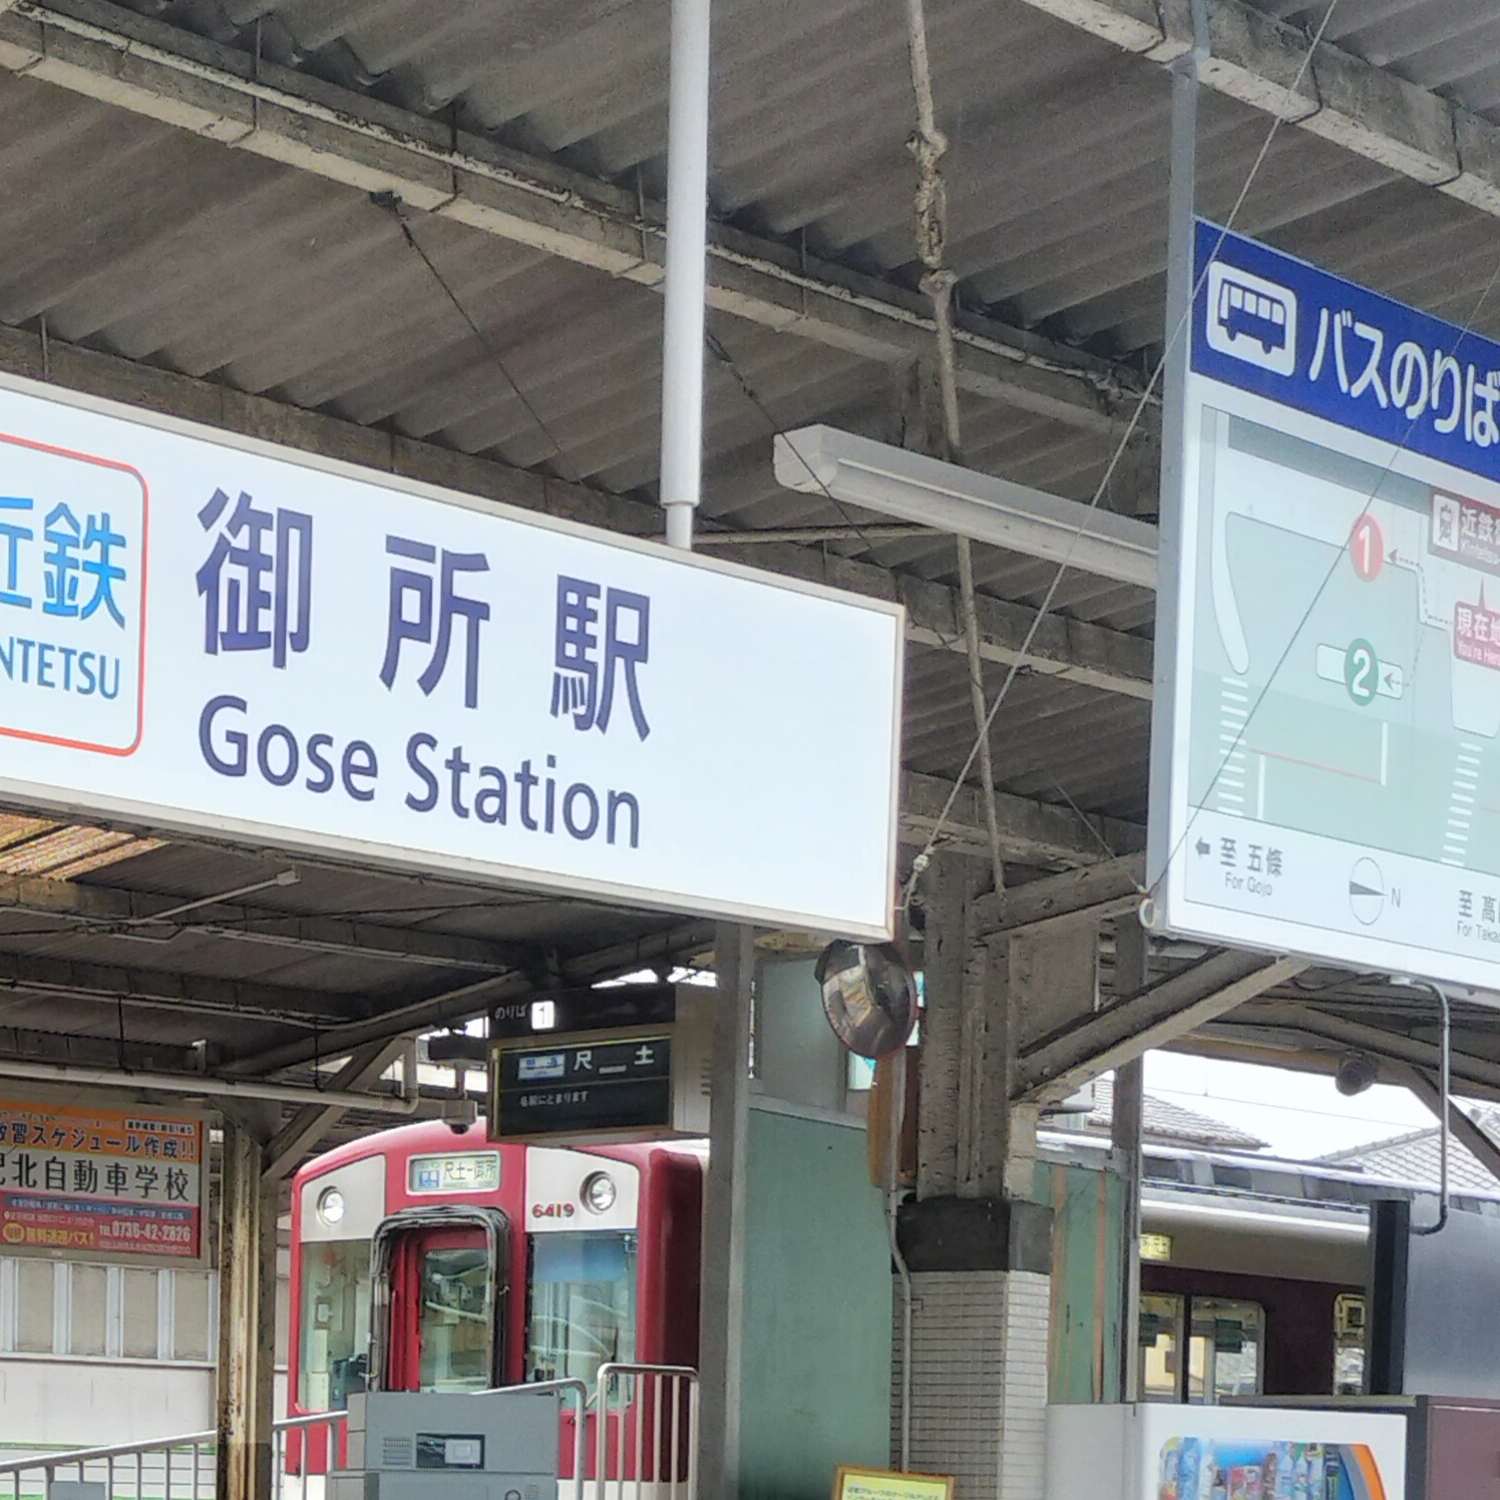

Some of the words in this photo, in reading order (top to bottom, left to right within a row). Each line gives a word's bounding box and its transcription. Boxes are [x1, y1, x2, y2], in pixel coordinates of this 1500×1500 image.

[1308, 307, 1500, 448] バスのりば
[1358, 525, 1372, 575] 1
[196, 487, 650, 742] 御所駅
[1350, 647, 1371, 697] 2
[199, 694, 378, 802] Gose
[404, 732, 640, 849] Station
[1224, 872, 1244, 891] For
[1246, 877, 1274, 898] Gojo
[1390, 887, 1402, 908] N
[1480, 895, 1500, 924] 高
[1456, 920, 1474, 939] For
[495, 1003, 528, 1021] のりば
[531, 1202, 575, 1219] 6419
